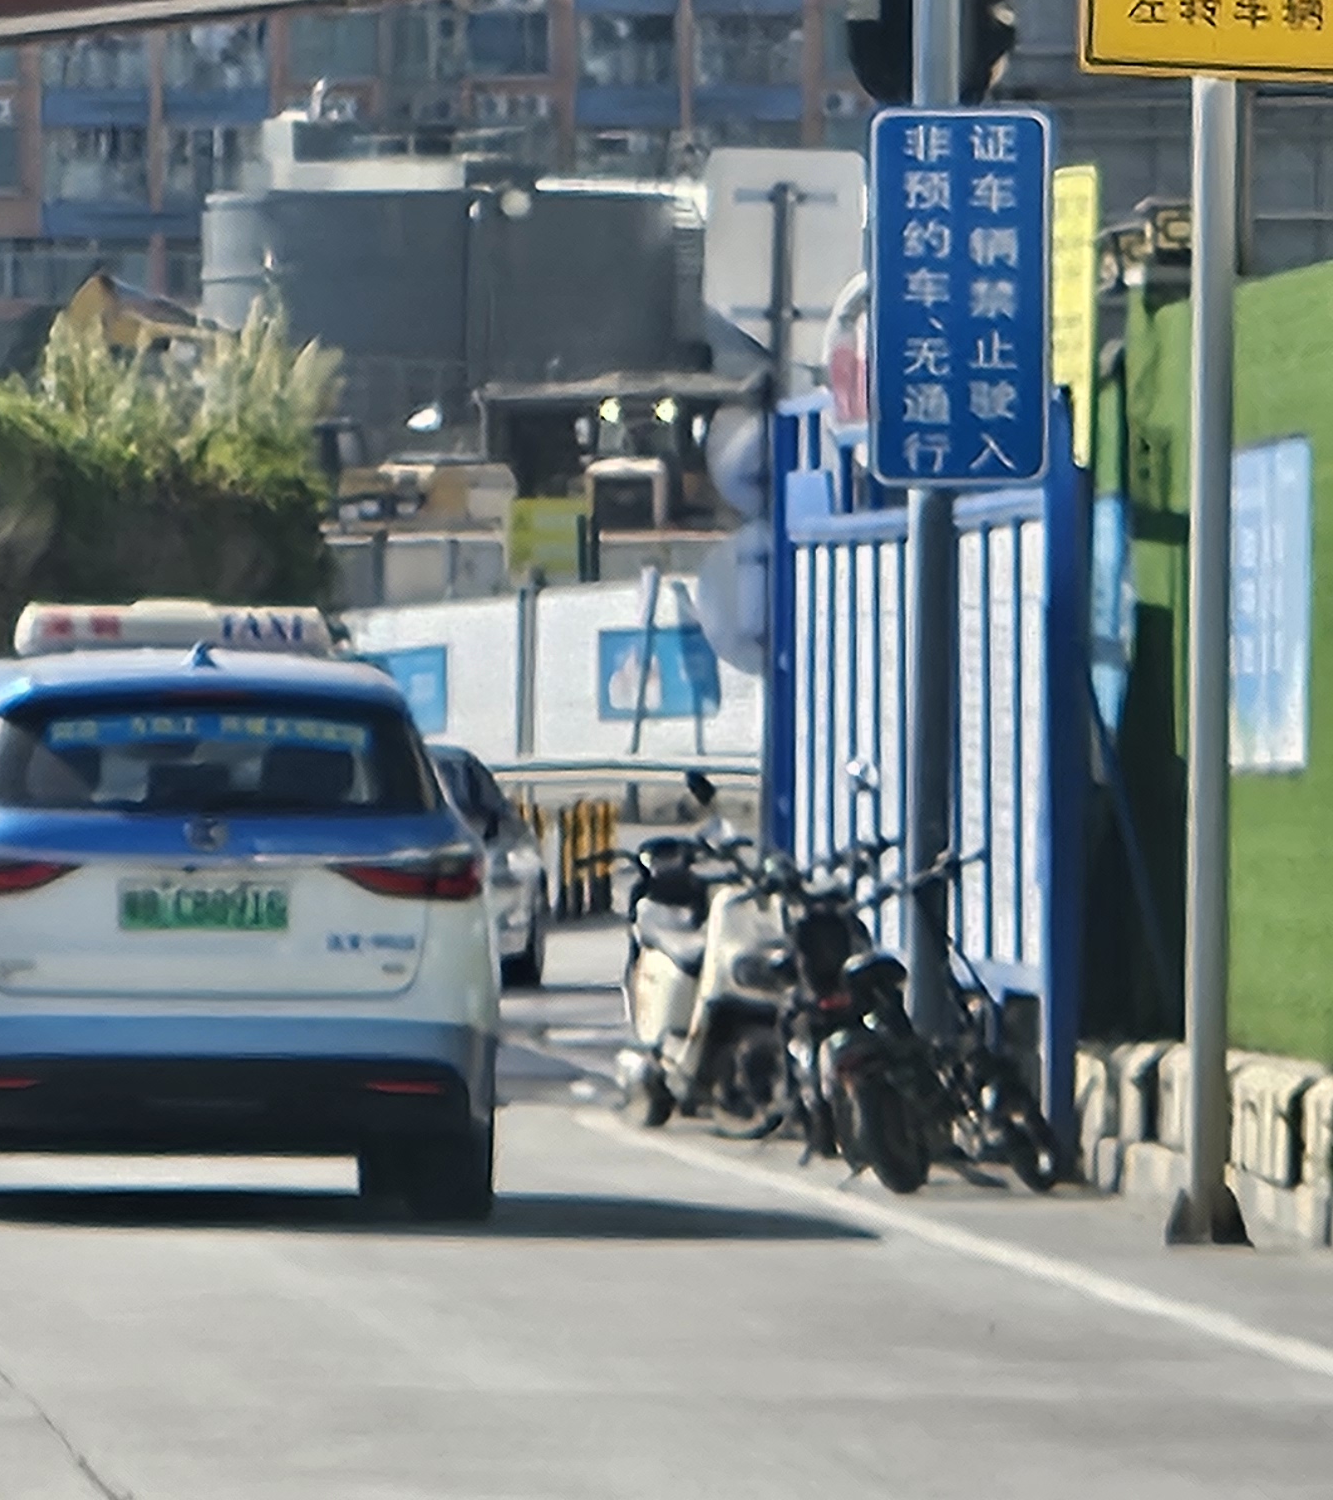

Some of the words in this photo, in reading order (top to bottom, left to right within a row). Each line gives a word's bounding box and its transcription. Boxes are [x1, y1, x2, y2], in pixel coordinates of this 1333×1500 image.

[902, 123, 952, 474] 非预约车、无通行
[967, 123, 1020, 472] 证车辆禁止驶入
